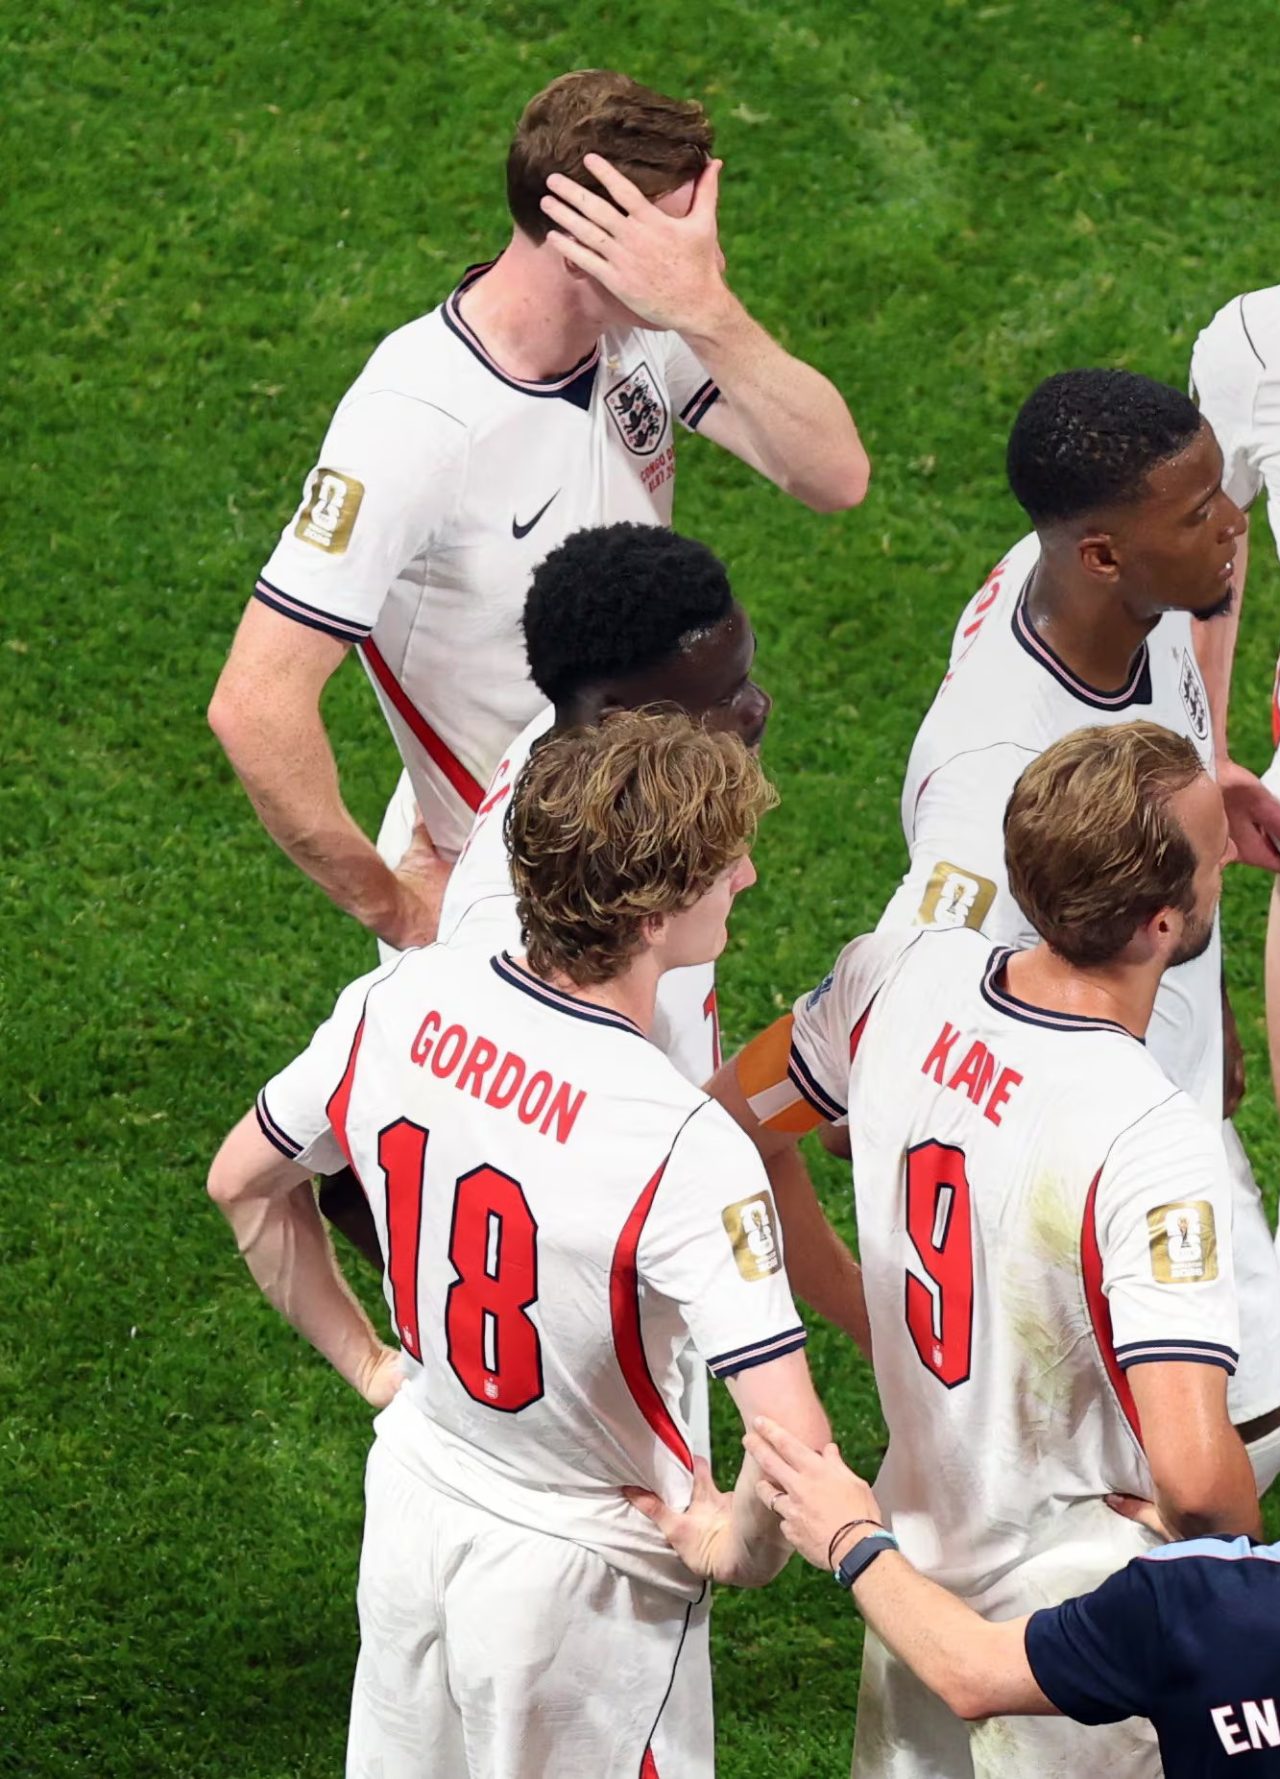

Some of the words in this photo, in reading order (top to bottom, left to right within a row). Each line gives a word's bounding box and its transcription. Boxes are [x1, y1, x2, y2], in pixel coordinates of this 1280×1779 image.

[409, 1010, 587, 1145] GORDON
[920, 1022, 1024, 1127] KANE
[376, 1116, 545, 1414] 18
[904, 1137, 974, 1389] 9
